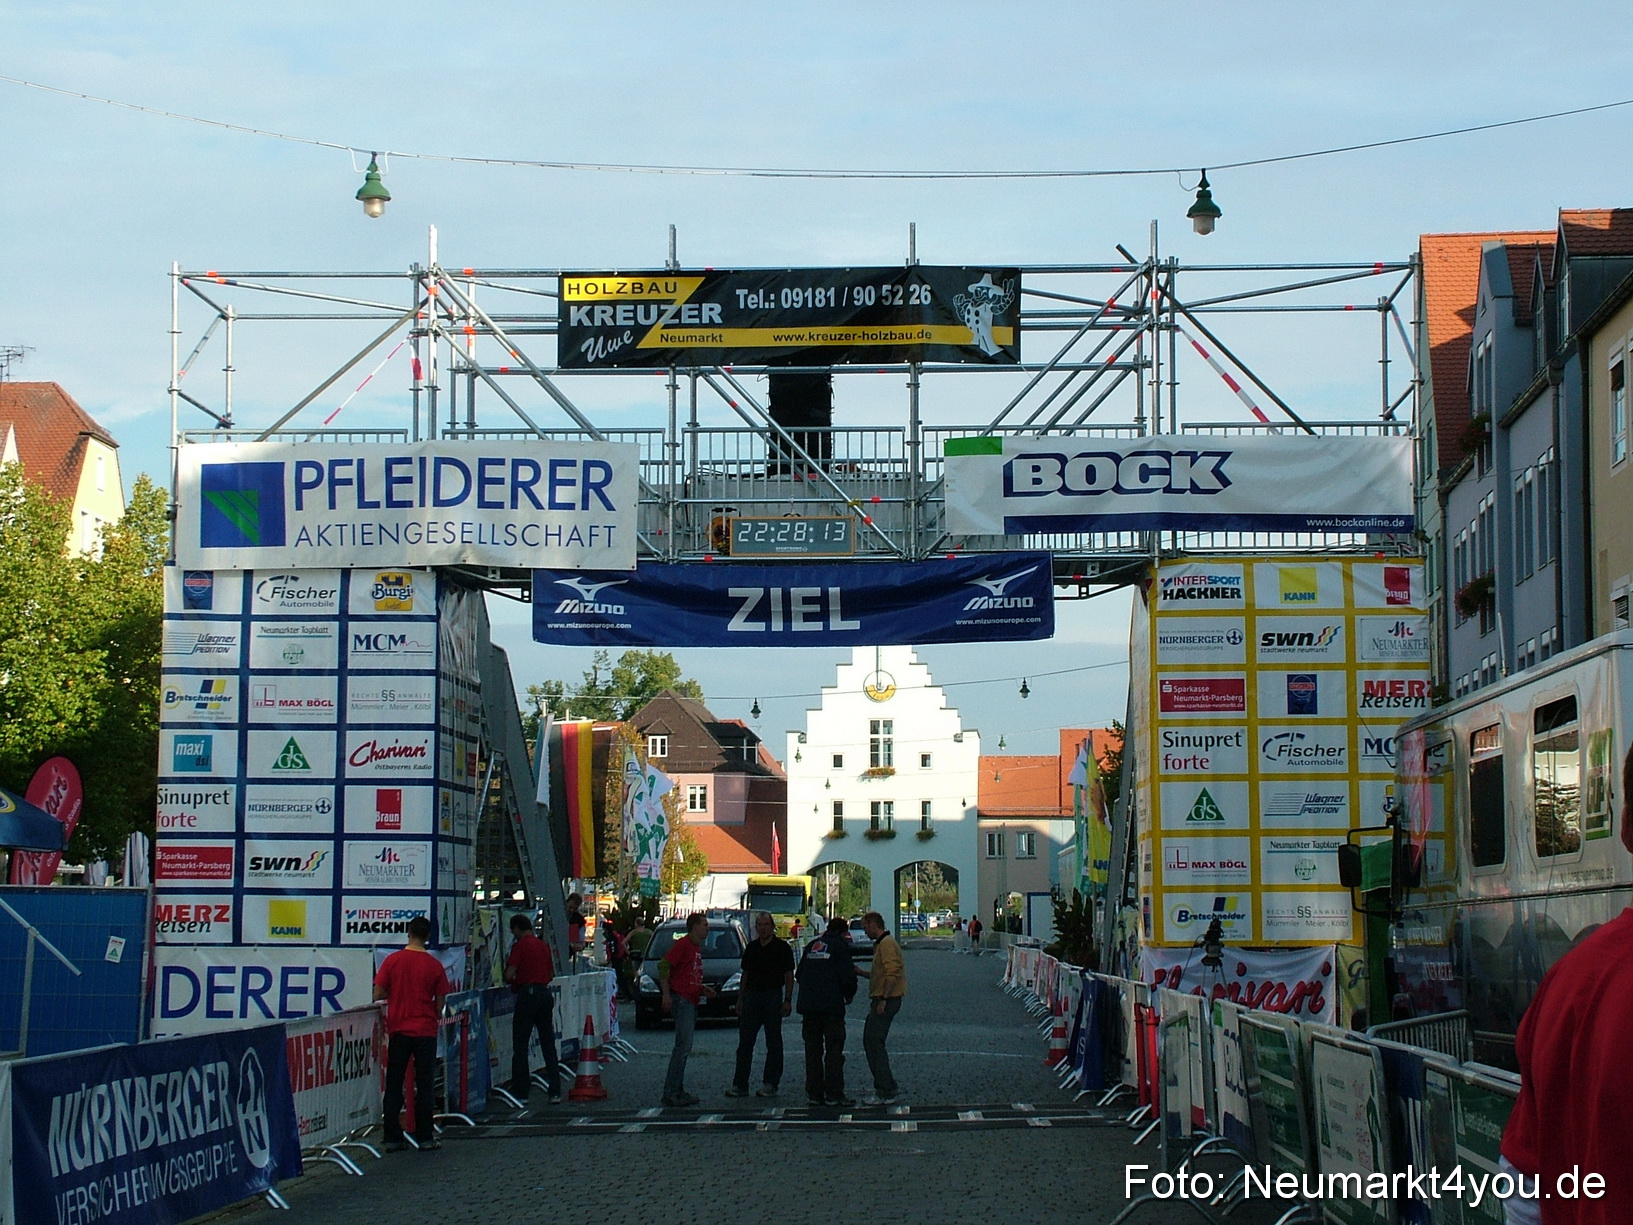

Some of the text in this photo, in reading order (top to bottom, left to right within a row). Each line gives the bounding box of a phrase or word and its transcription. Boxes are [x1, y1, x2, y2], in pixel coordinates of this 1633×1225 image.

[568, 281, 678, 296] HOLZBAU
[736, 283, 932, 309] Tel.: 09181 / 90 52 26
[569, 302, 722, 327] KREUZER
[659, 329, 933, 344] Neumarkt www.kreuzer-holzbau.de
[581, 330, 633, 363] Uwe
[1003, 450, 1234, 498] BOCK
[294, 457, 617, 512] PFLEIDERER
[1306, 517, 1406, 529] www.bockonline.de
[294, 521, 617, 548] AKTIENGESELLSCHAFT
[738, 522, 846, 543] 22:28:13
[1174, 576, 1241, 586] INTERSPORT
[271, 586, 337, 600] Fischer
[1162, 588, 1242, 600] HACKNER
[1284, 592, 1315, 600] KANN
[727, 586, 861, 633] ZIEL
[547, 621, 631, 631] www.mizunoeurope.com
[955, 616, 1042, 627] www.mizunoeurope.com
[302, 626, 328, 635] Tagblatt
[198, 633, 236, 645] Wagner
[353, 634, 406, 650] MCM
[1159, 635, 1224, 644] NÜRNBERGER
[1261, 632, 1314, 647] swn
[1174, 685, 1209, 694] Sparkasse
[165, 690, 232, 703] Bretschneider
[279, 698, 334, 707] MAX BÖGL
[1174, 694, 1243, 703] Neumarkt-Parsberg
[1360, 692, 1426, 708] Reisen
[1163, 731, 1242, 751] Sinupret
[1364, 737, 1395, 754] MC
[176, 740, 205, 756] maxi
[349, 739, 428, 767] Charivari
[1278, 744, 1345, 757] Fischer
[196, 756, 211, 767] dsl
[413, 763, 432, 771] Radio
[1163, 754, 1209, 770] forte
[1305, 793, 1344, 804] Wagner
[248, 802, 313, 812] NÜRNBERGER
[376, 811, 399, 823] Braun
[162, 862, 230, 870] Neumarkt-Parsberg
[249, 856, 301, 871] swn
[359, 864, 415, 876] NEUMARKTER
[1219, 860, 1247, 869] BÖGL
[156, 905, 230, 922] MERZ
[1178, 910, 1246, 923] Bretschneider
[271, 927, 302, 935] KANN
[335, 1025, 371, 1083] Reisen
[48, 1061, 234, 1178] NÜRNBERGER
